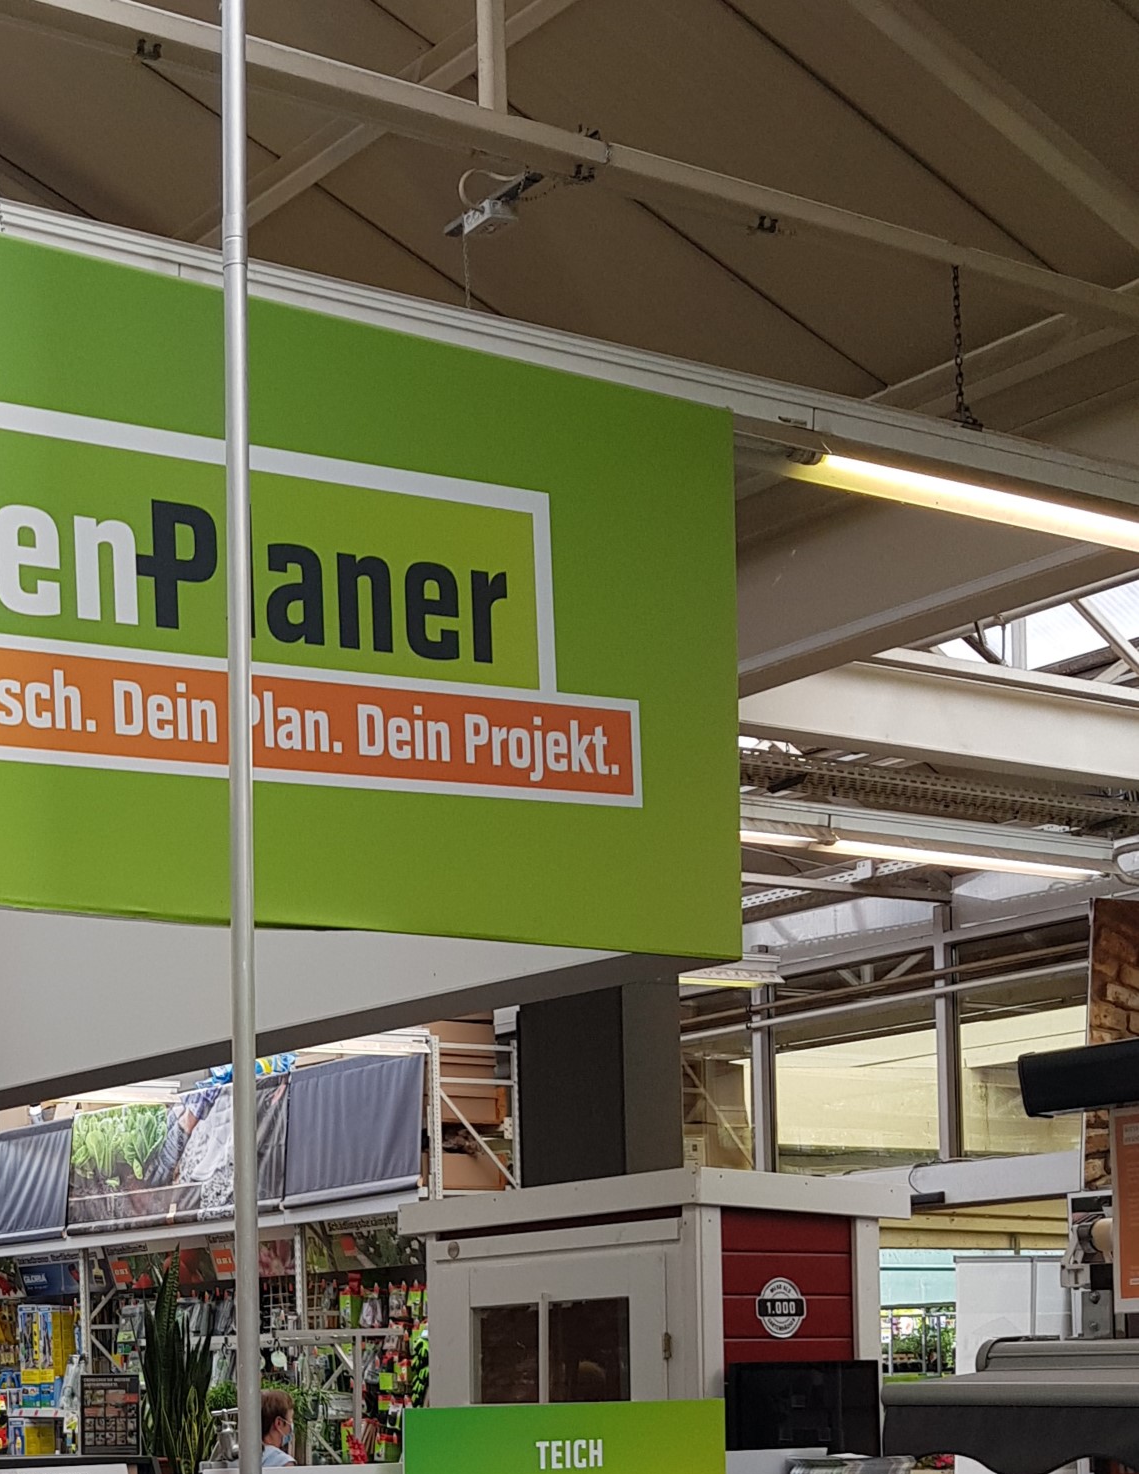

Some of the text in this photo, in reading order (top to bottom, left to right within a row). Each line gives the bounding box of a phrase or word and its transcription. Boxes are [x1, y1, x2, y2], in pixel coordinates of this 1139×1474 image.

[114, 681, 218, 743] Dein
[357, 704, 452, 763] Dein
[464, 713, 621, 783] Projekt.
[766, 1301, 796, 1314] 1.000
[536, 1439, 604, 1470] TEICH
